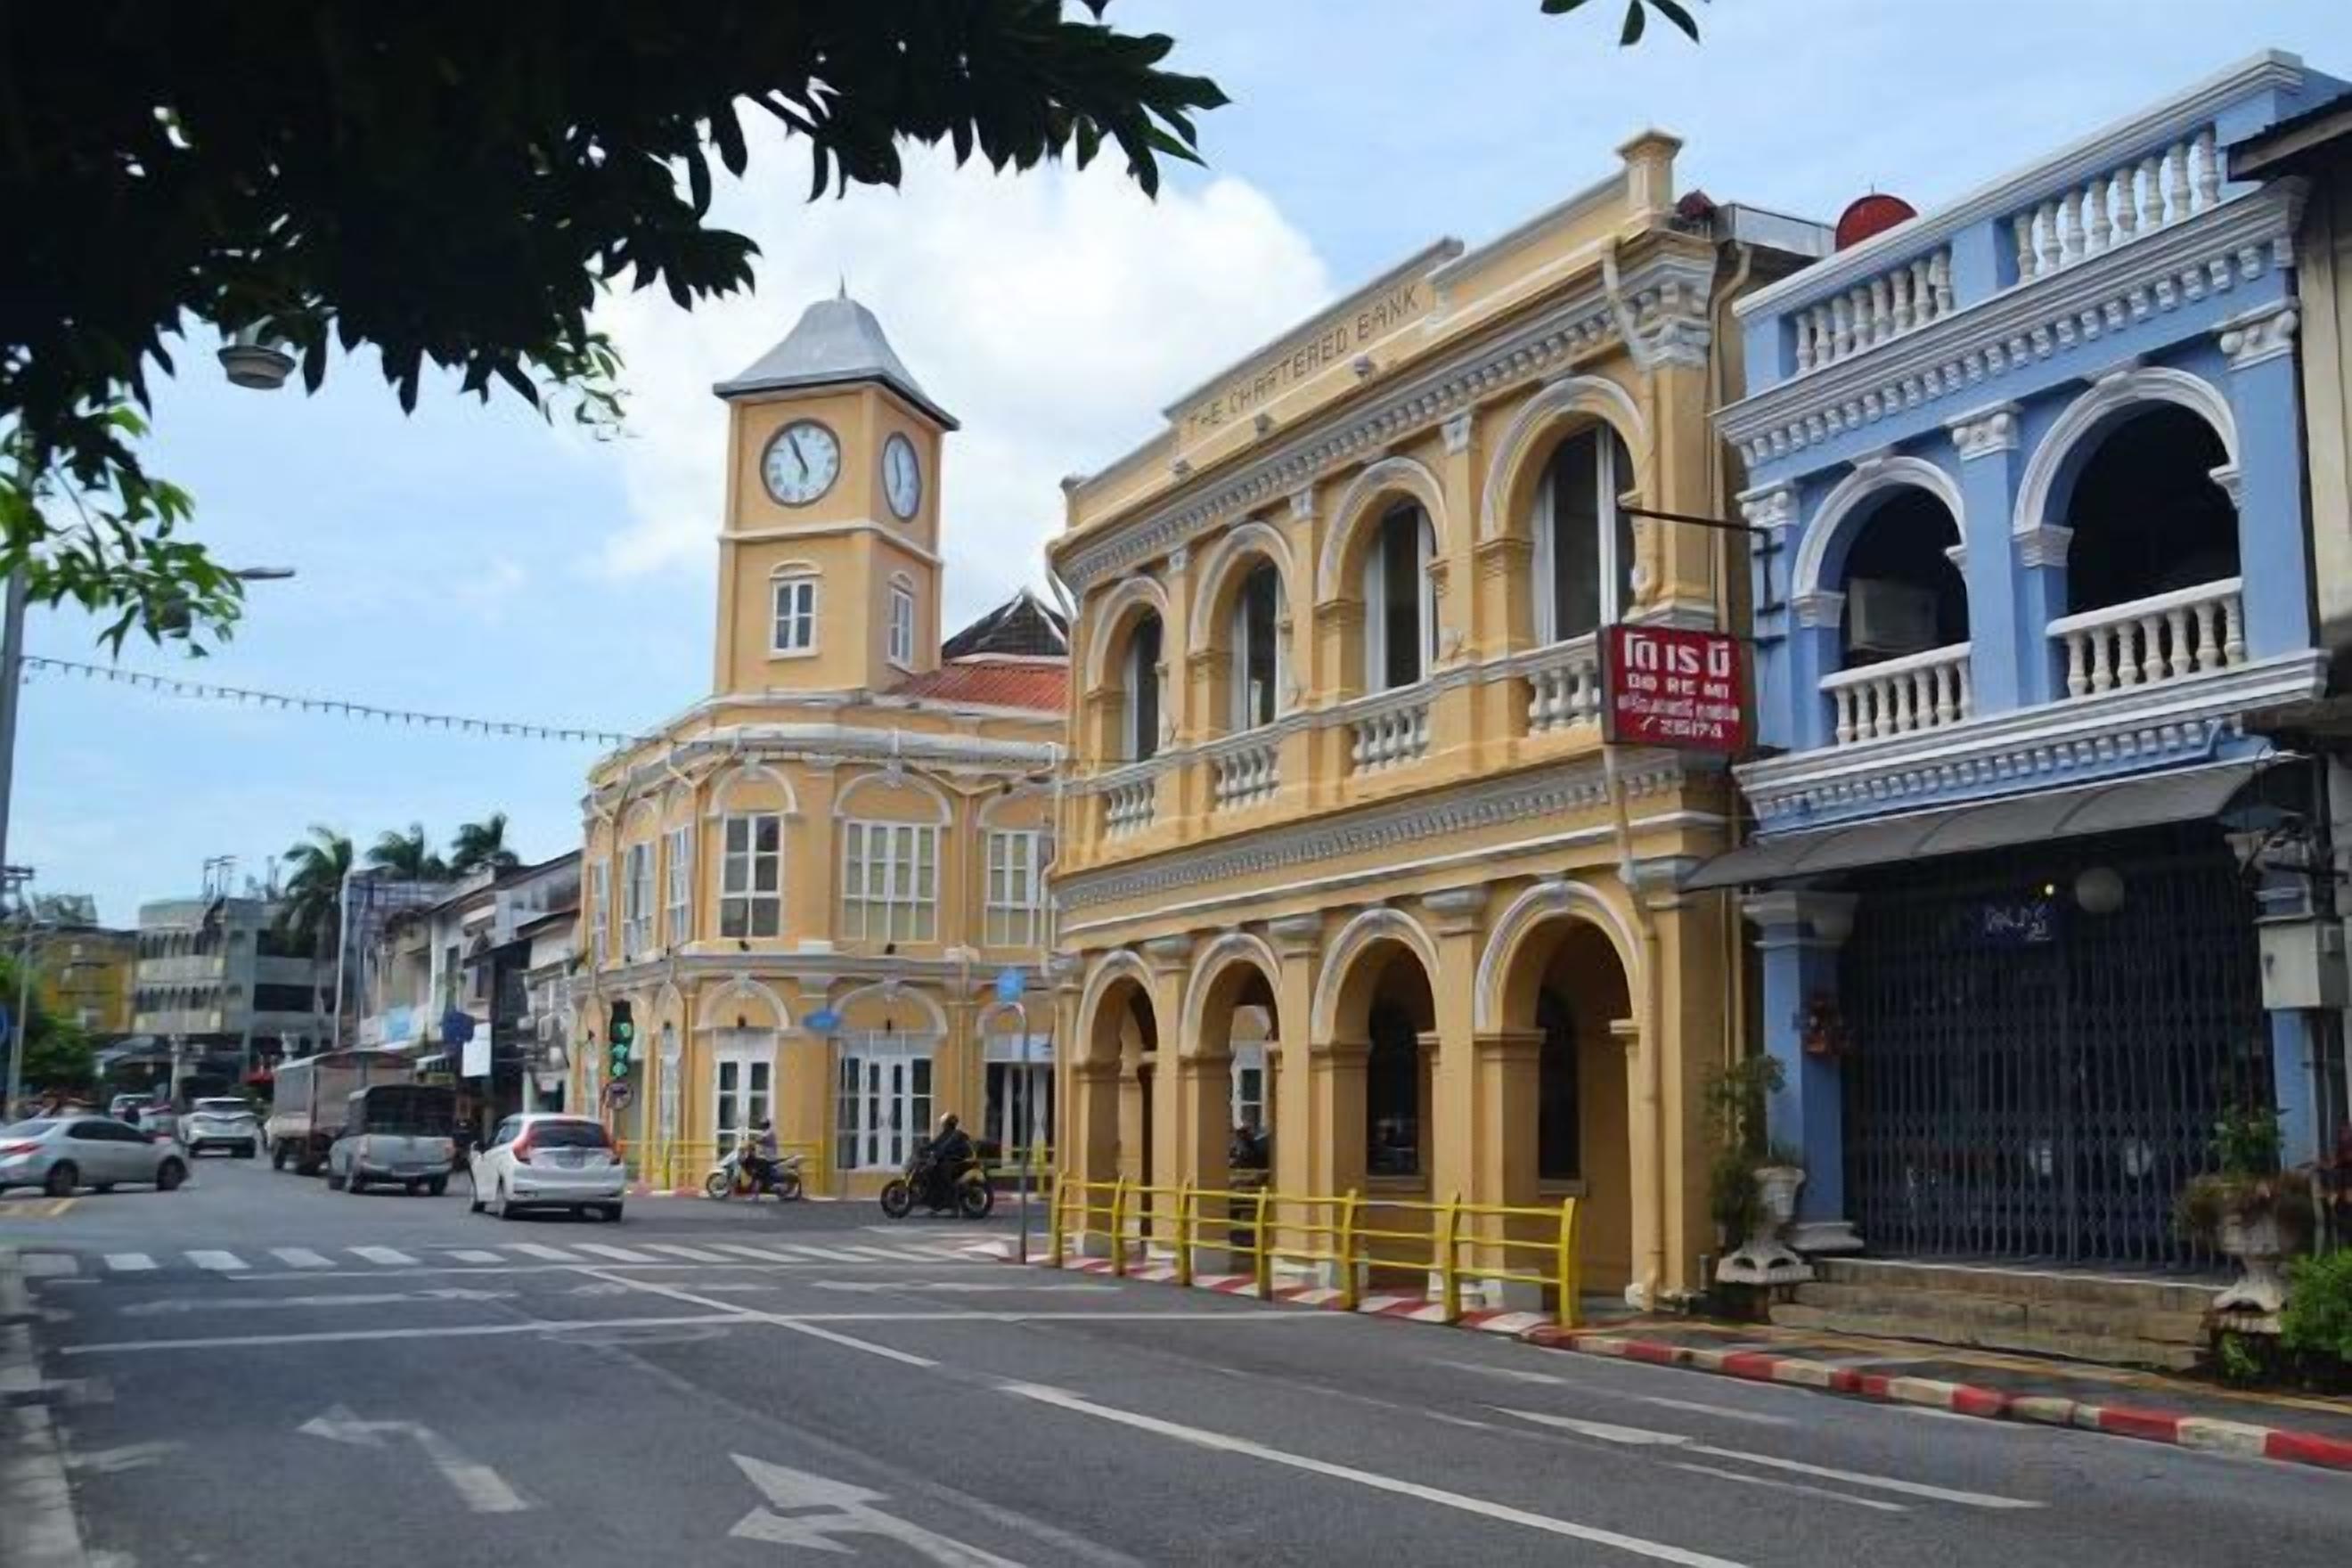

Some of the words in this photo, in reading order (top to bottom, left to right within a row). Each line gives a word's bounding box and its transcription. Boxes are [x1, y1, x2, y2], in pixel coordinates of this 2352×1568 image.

[1229, 326, 1348, 413] CHARTERED
[1357, 284, 1420, 341] BANK
[1627, 673, 1657, 692] DO
[1666, 677, 1696, 695] RE
[1703, 682, 1729, 698] MI
